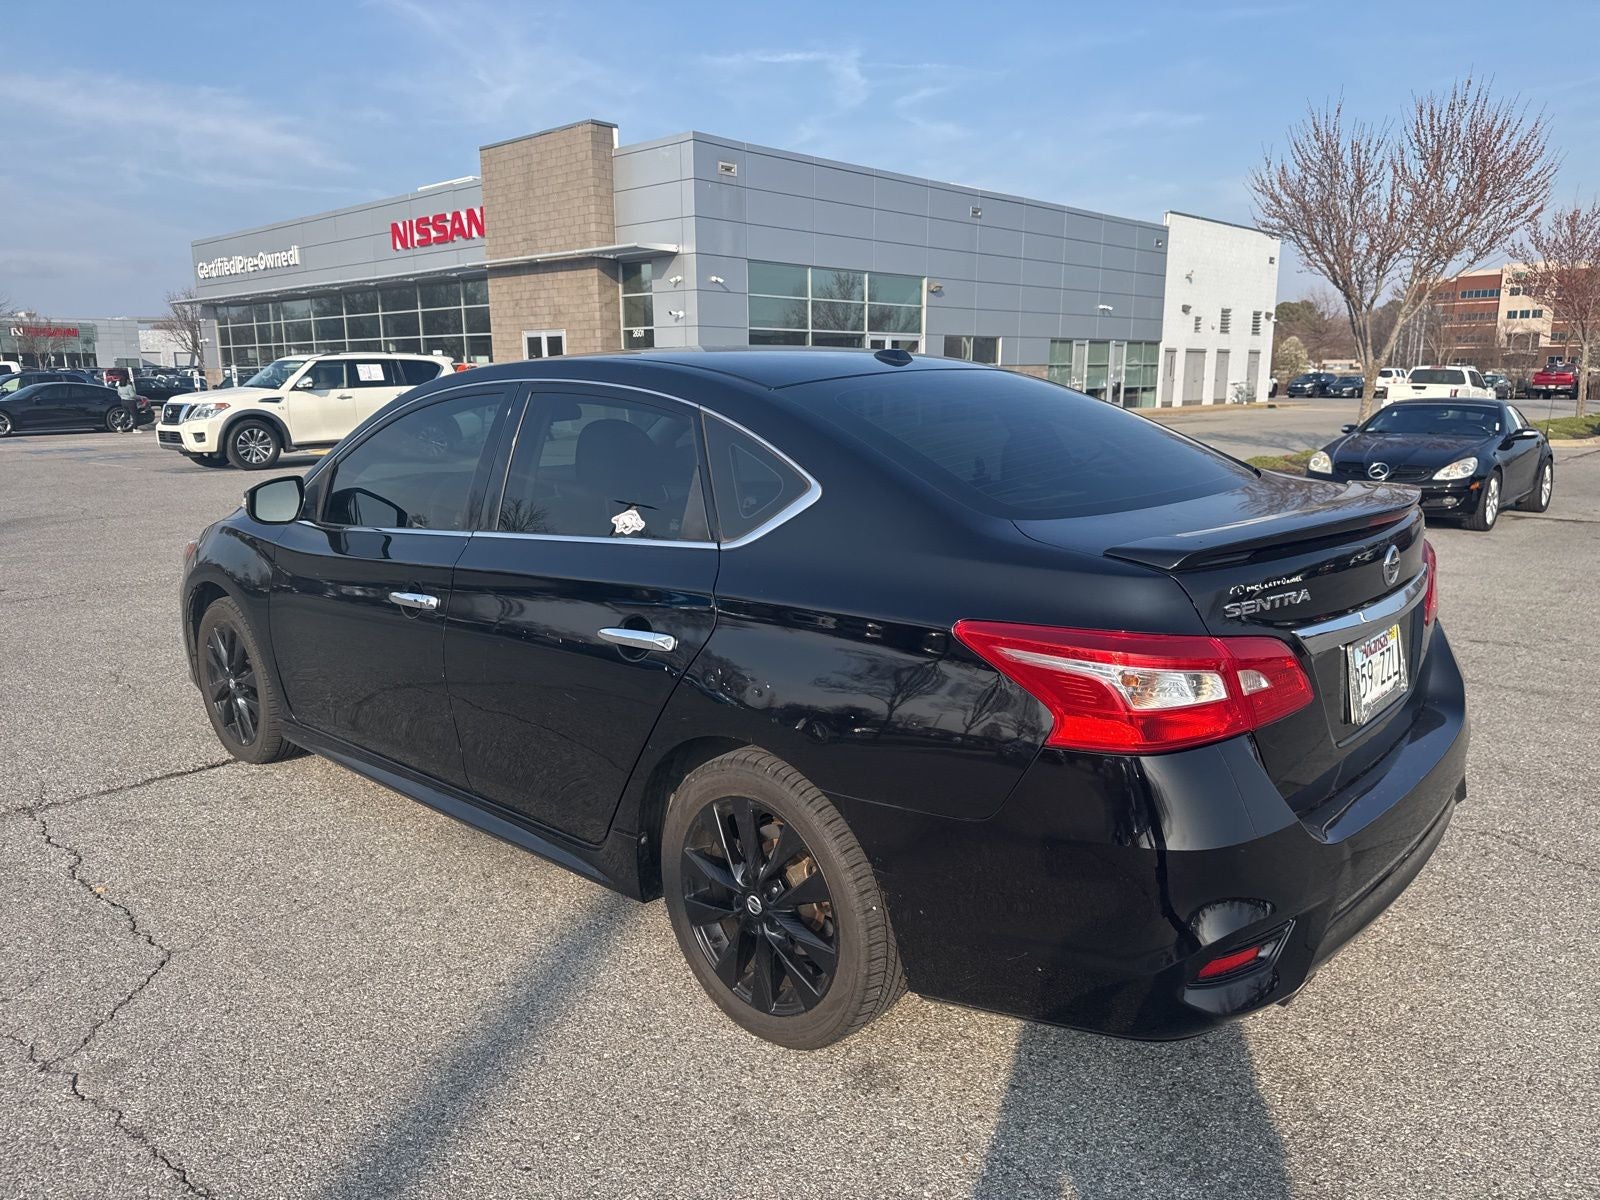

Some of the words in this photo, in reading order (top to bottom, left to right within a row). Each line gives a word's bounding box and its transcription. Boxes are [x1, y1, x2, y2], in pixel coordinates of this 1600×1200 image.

[390, 206, 485, 251] NISSAN
[198, 256, 237, 278] Certified
[236, 245, 299, 273] Pre-Owned
[1223, 589, 1311, 618] SENTRA
[1380, 644, 1399, 685] ZZL
